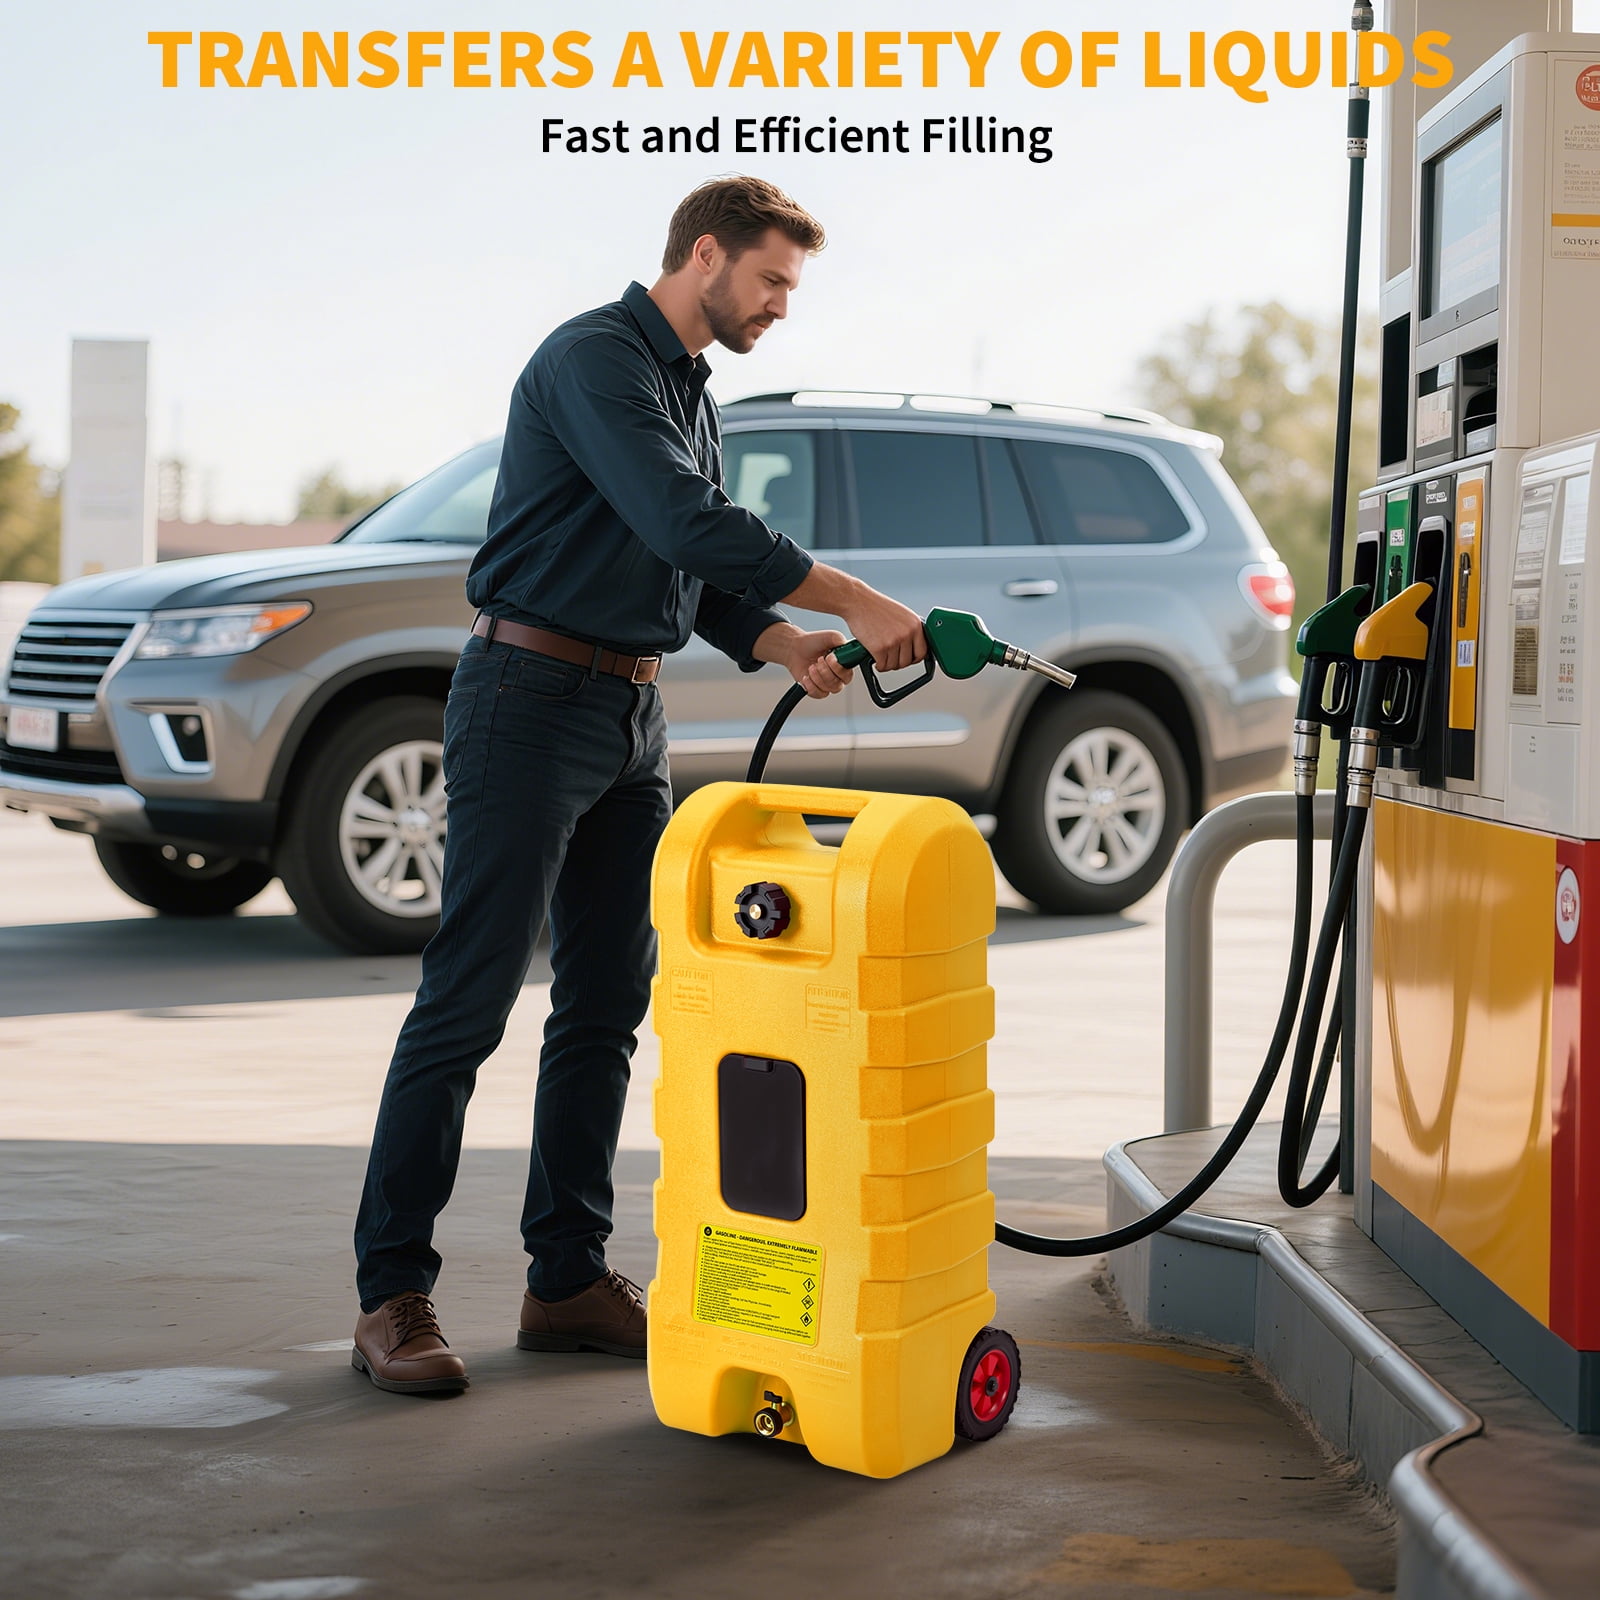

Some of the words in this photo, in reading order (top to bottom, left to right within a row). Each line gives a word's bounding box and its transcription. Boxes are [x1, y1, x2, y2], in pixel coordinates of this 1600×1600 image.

[715, 1230, 737, 1239] GASOLINE
[767, 1240, 791, 1250] EXTREMELY
[791, 1245, 818, 1256] FLAMMABLE
